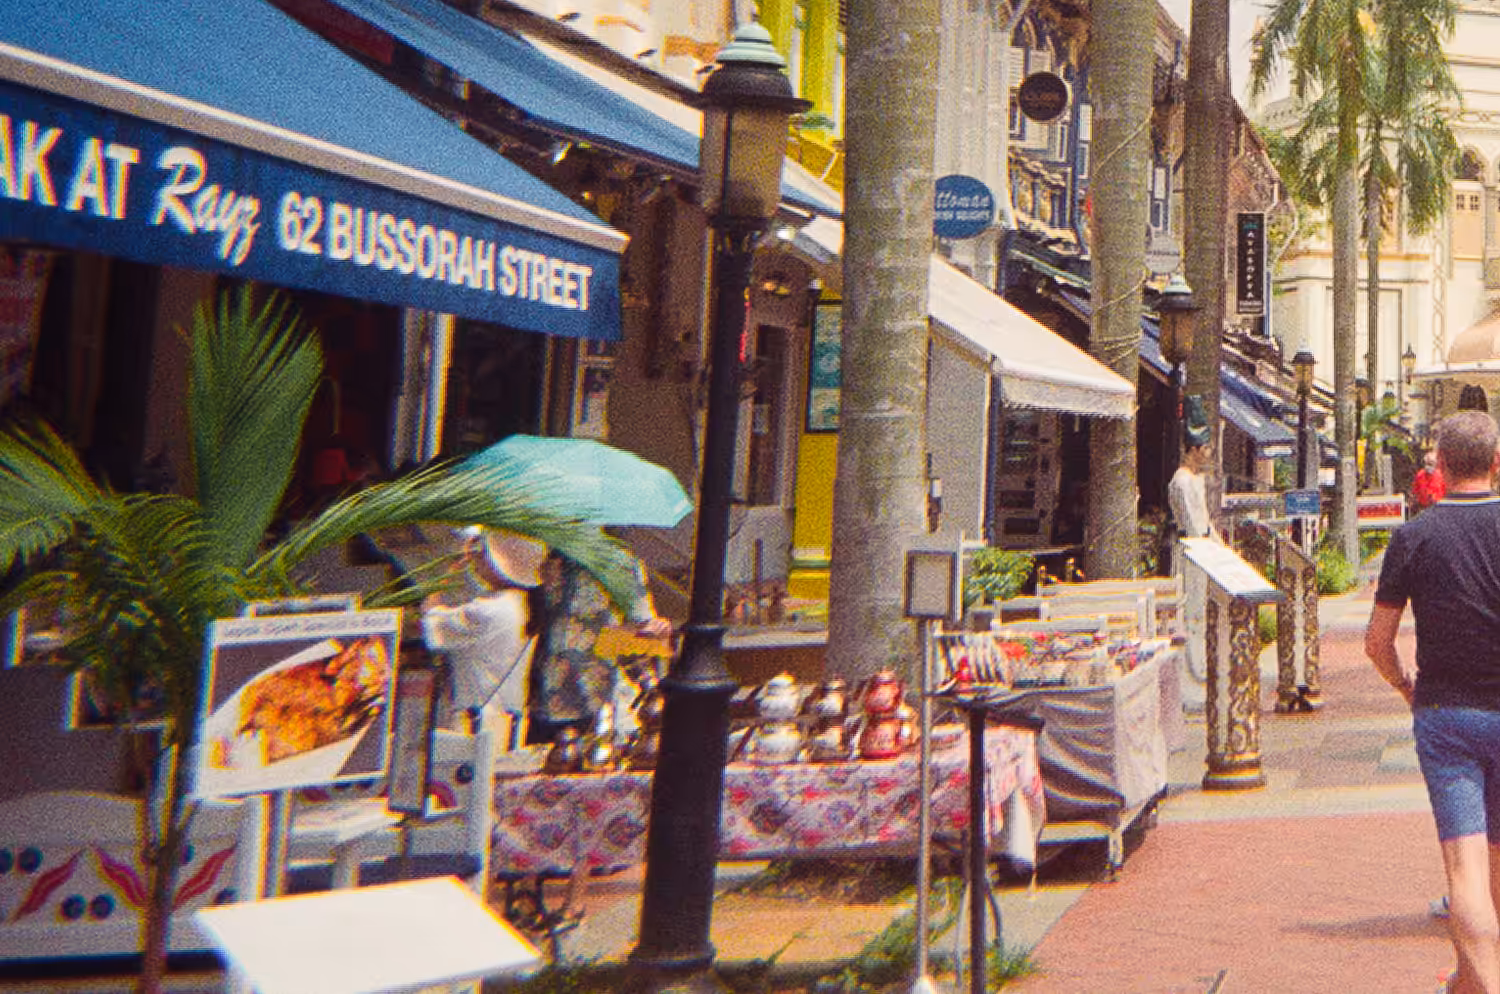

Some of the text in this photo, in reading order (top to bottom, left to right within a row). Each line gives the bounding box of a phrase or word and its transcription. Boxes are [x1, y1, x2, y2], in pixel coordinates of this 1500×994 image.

[65, 136, 140, 220] AT
[150, 146, 261, 266] Rayz
[278, 192, 322, 254] 62
[328, 202, 496, 291] BUSSORAH
[500, 245, 593, 311] STREET
